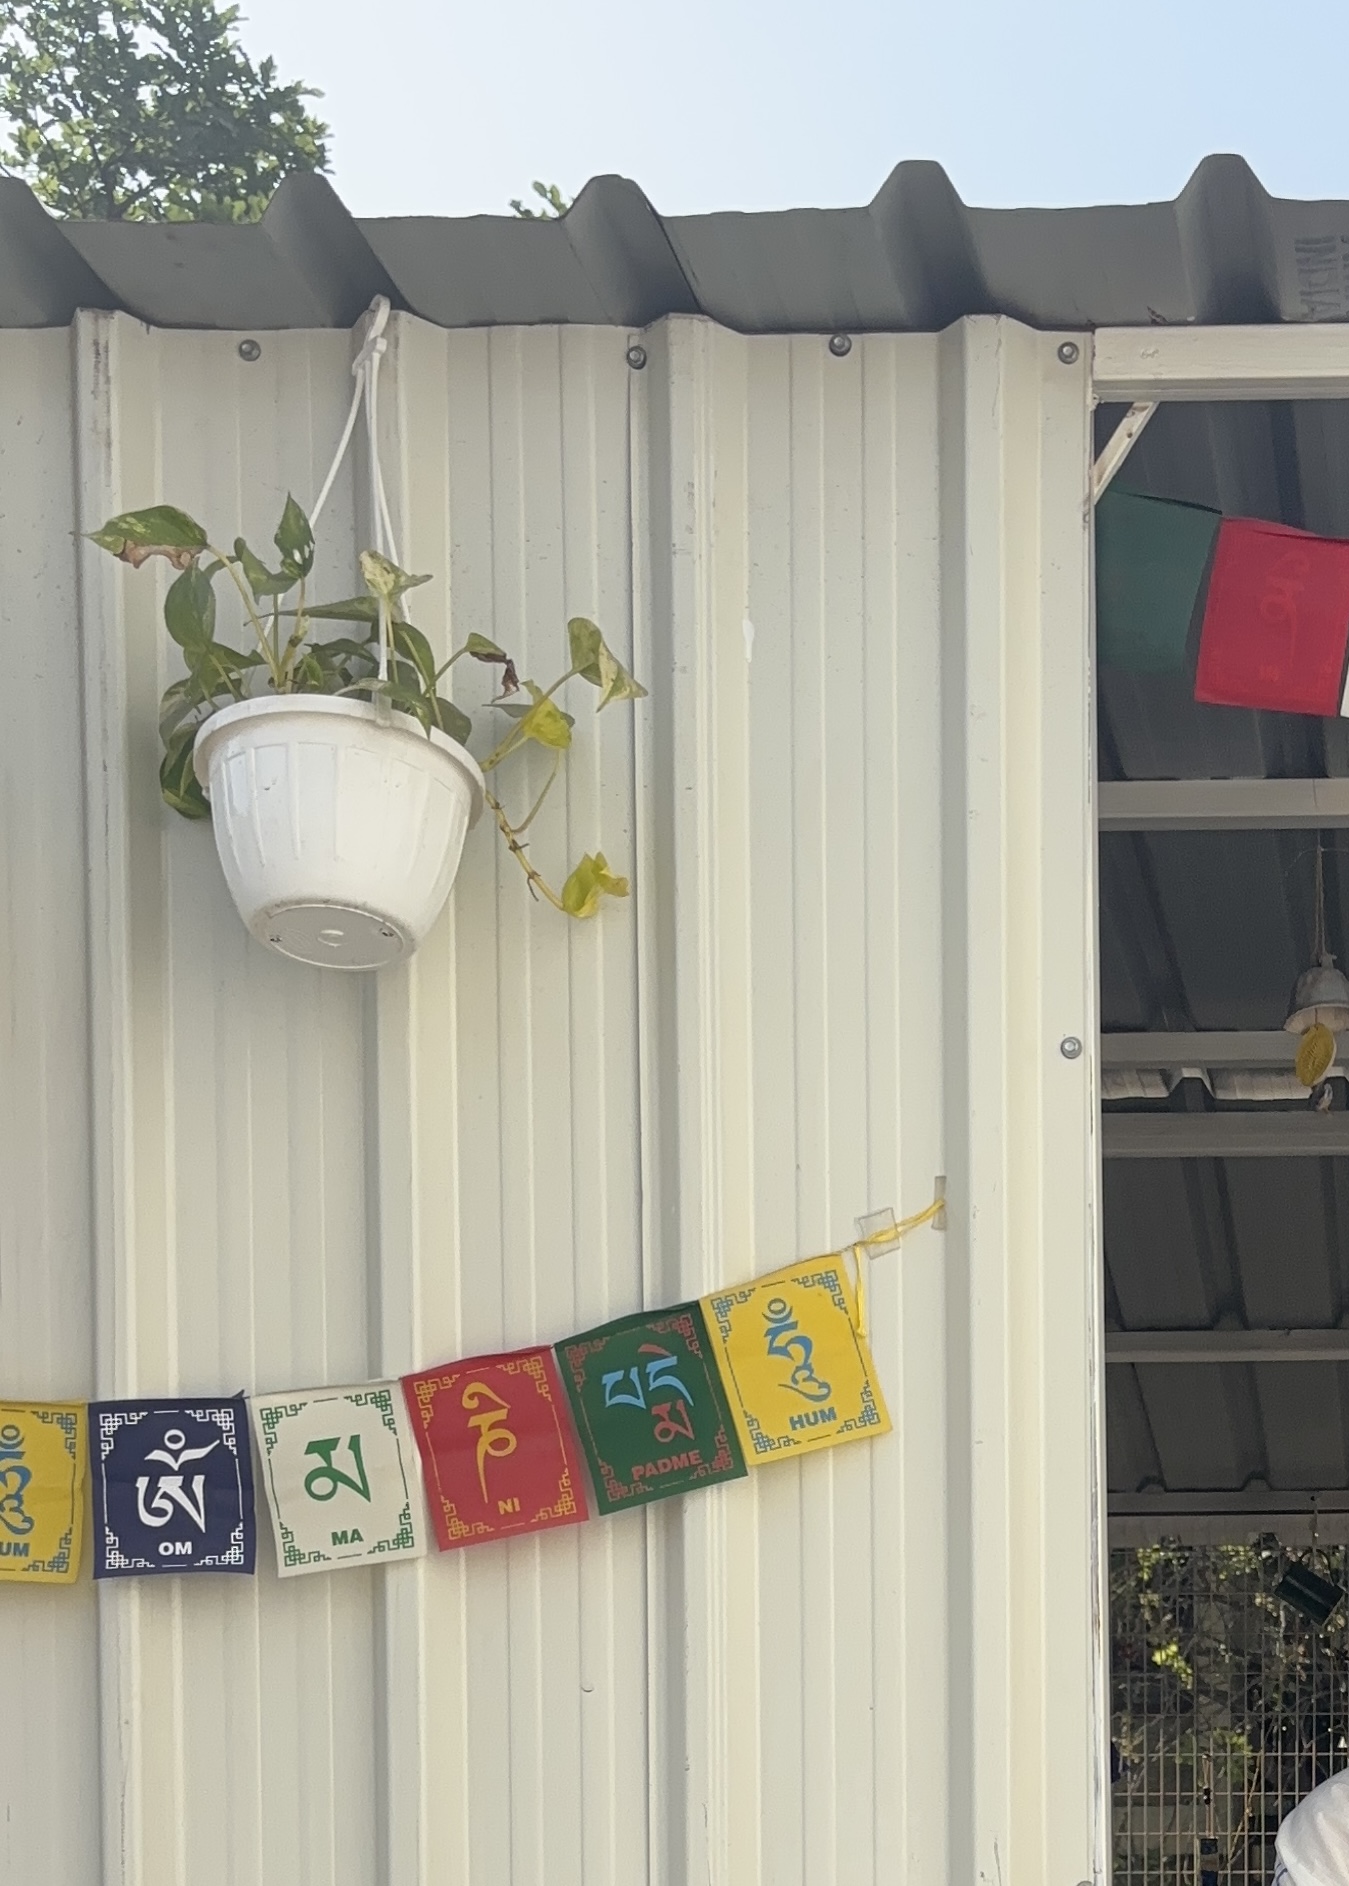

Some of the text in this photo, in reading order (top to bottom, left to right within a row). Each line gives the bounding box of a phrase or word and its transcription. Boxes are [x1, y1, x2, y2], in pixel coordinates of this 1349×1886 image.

[788, 1406, 838, 1431] HUM
[631, 1449, 704, 1482] PADME
[497, 1496, 521, 1516] NI
[331, 1528, 365, 1546] MA
[0, 1542, 30, 1558] UM
[158, 1541, 193, 1556] OM
